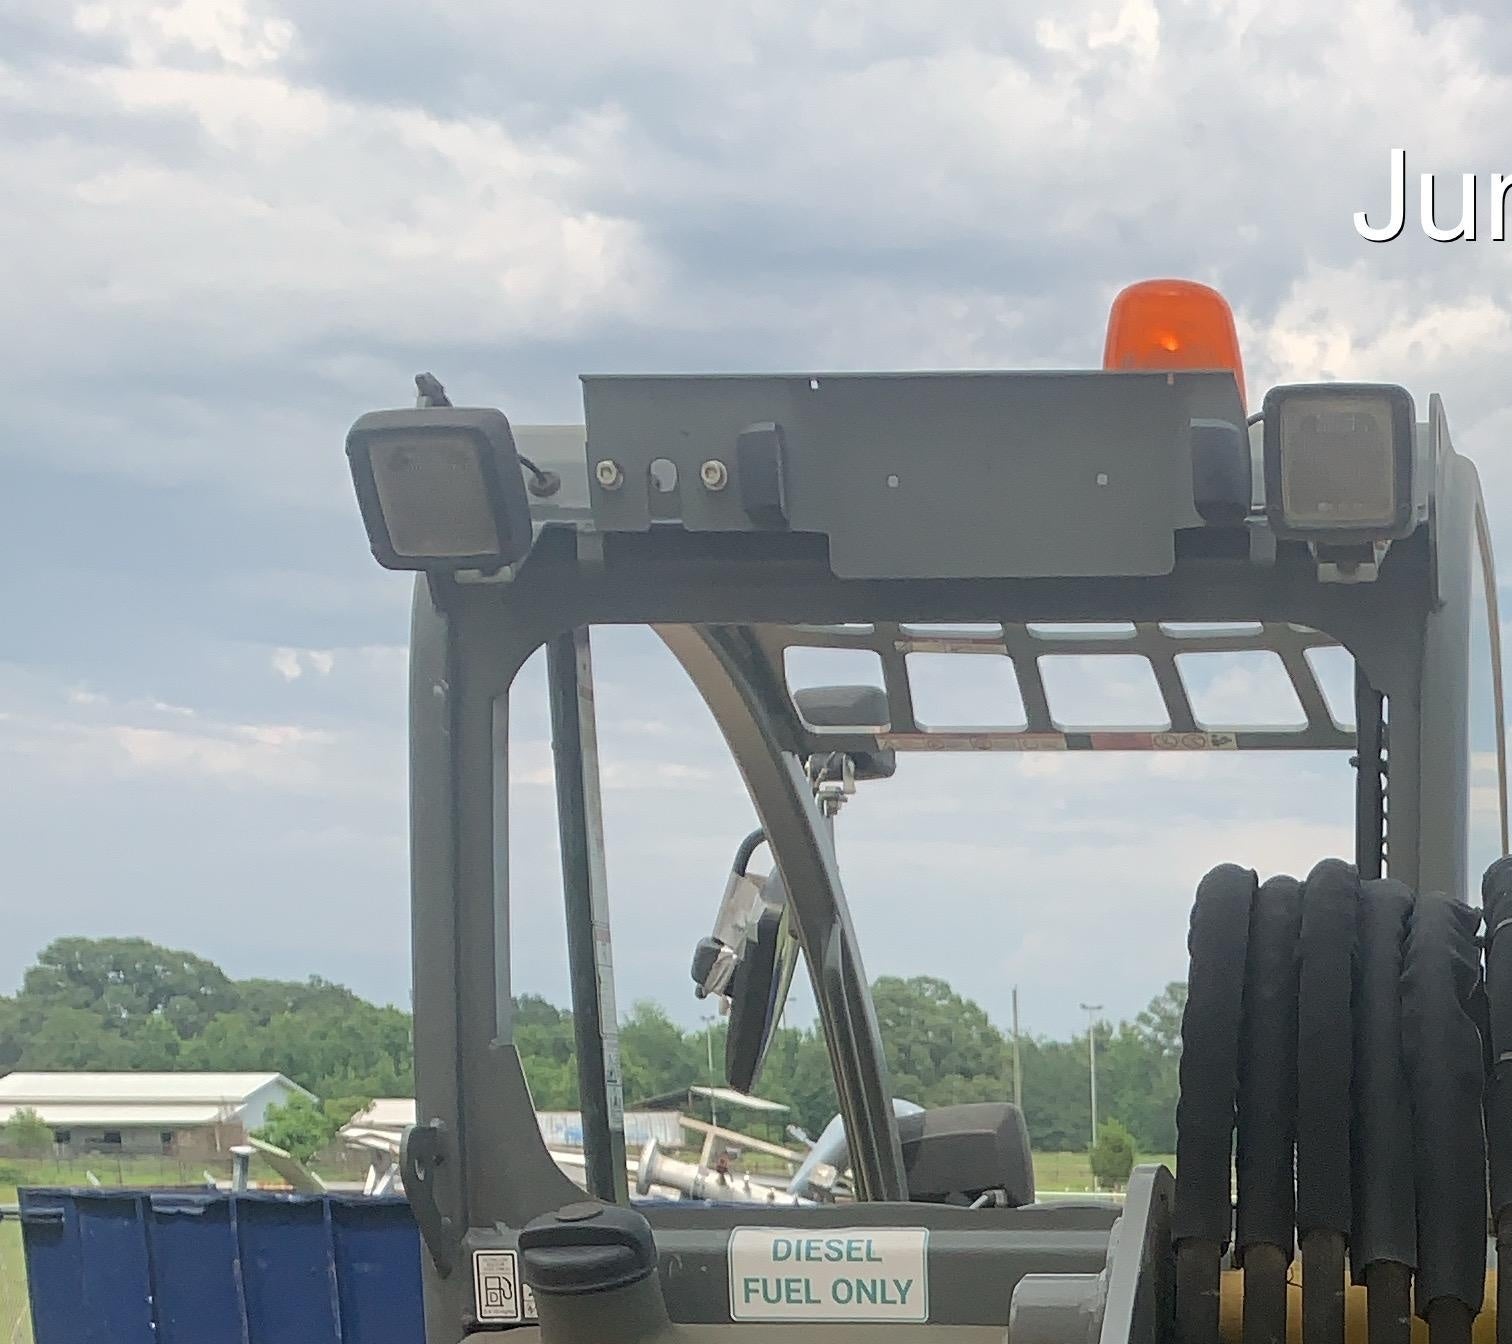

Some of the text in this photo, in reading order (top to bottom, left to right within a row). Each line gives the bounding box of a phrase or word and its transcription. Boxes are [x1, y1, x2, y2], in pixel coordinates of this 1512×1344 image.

[772, 1238, 883, 1262] DIESEL
[743, 1277, 914, 1305] FUEL ONLY
